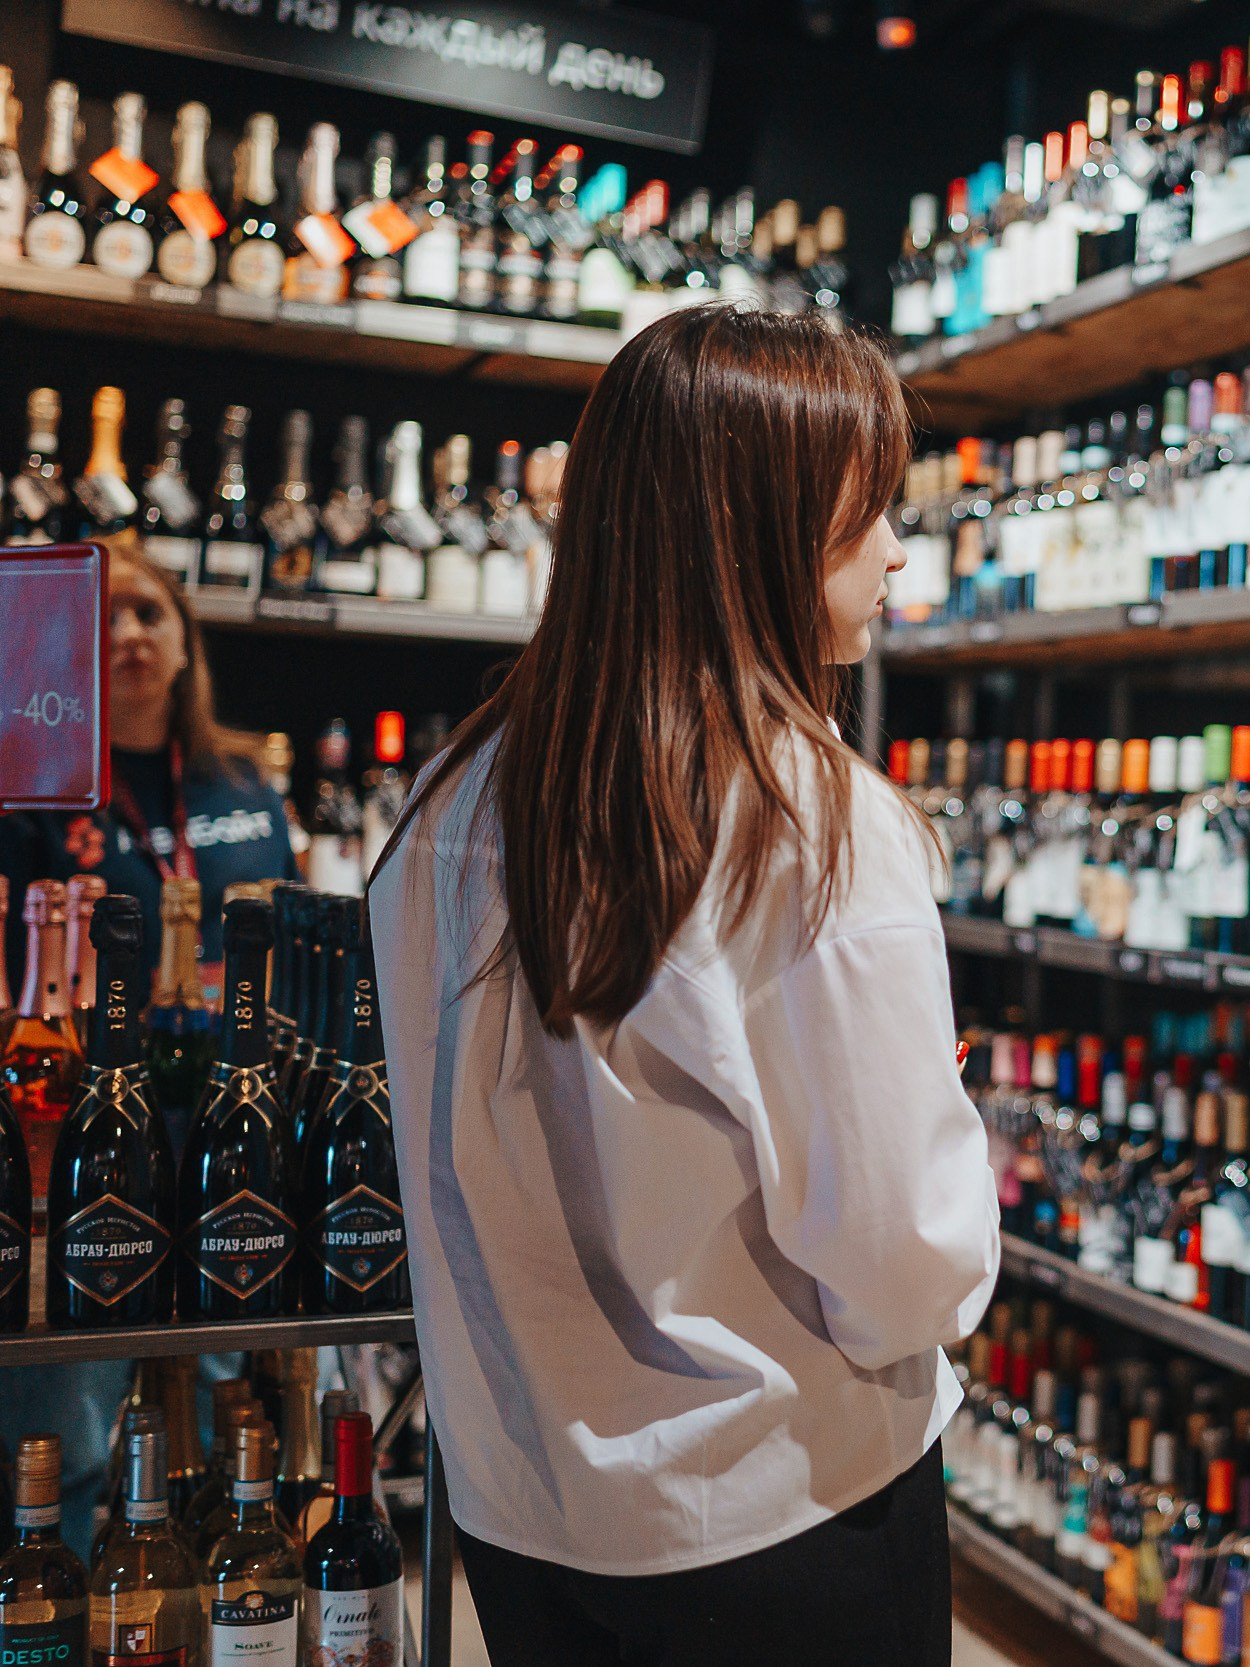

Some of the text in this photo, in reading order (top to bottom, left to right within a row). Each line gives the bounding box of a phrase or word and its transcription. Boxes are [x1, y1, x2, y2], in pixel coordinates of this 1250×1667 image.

[352, 2, 546, 76] каждый
[549, 41, 666, 100] день
[12, 691, 85, 727] -40%
[107, 979, 126, 1031] 1870
[235, 980, 253, 1031] 1870
[354, 978, 372, 1028] 1870
[65, 1240, 153, 1258] АБРАУ-ДЮРСО
[201, 1234, 285, 1252] АБРАУ-ДЮРСО
[321, 1228, 402, 1246] АБРАУ-ДЮРСО
[220, 1604, 287, 1619] CAVATINA
[2, 1644, 70, 1666] DESTO
